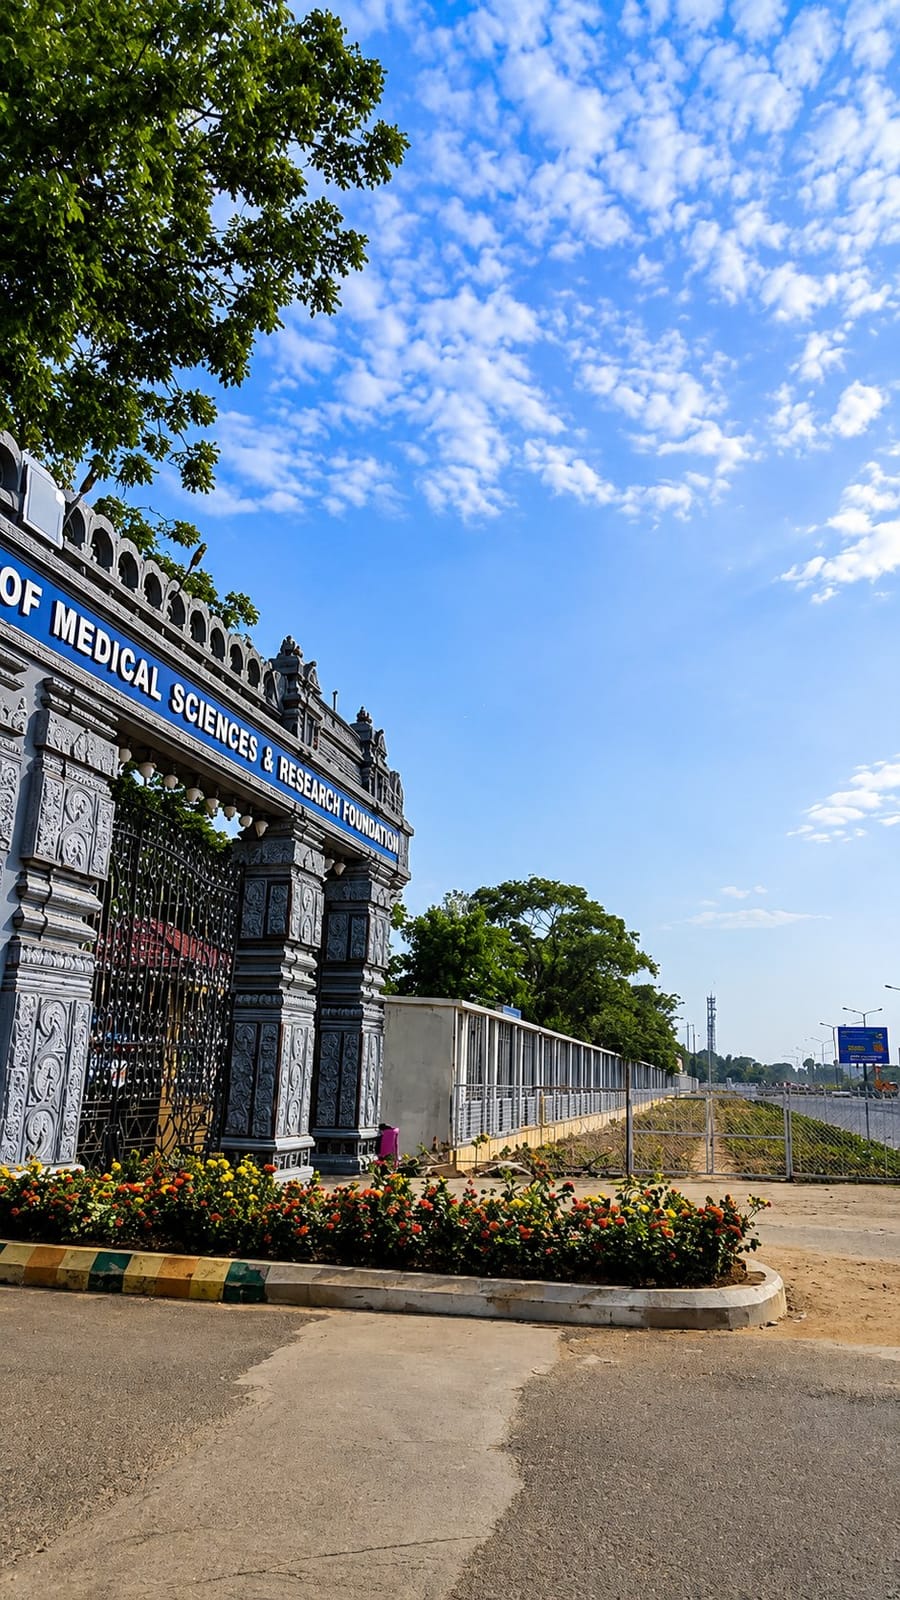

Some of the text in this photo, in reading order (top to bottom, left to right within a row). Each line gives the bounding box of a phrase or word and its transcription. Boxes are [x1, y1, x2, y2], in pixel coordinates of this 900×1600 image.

[0, 566, 399, 854] OF MEDICAL SCIENCES & RESEARCH FOUNDATION
